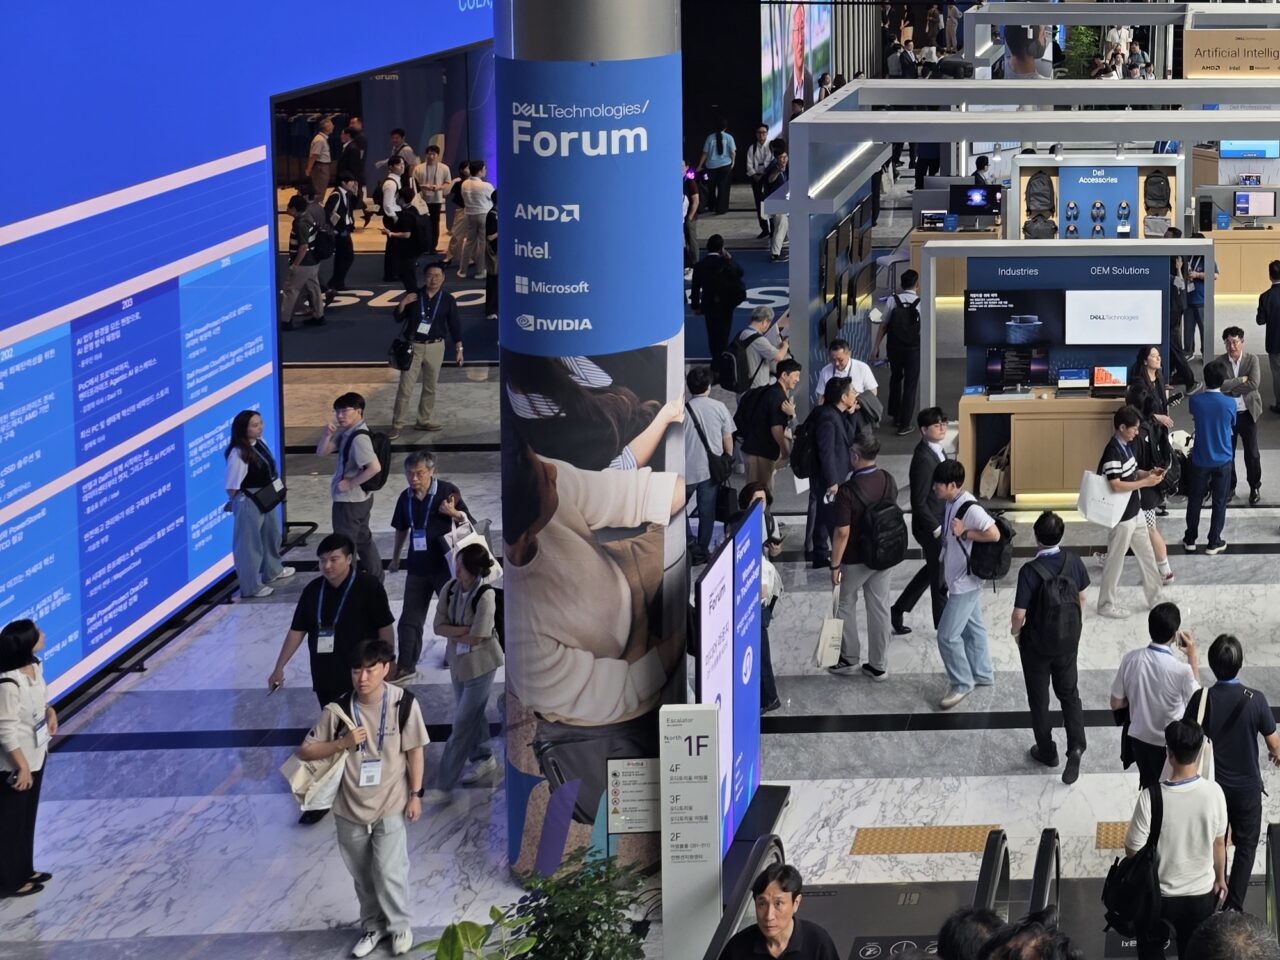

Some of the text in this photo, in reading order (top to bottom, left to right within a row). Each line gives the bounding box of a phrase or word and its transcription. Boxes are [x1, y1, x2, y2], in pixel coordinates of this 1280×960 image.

[1194, 48, 1240, 59] Artificial
[512, 120, 648, 157] Forum
[514, 203, 559, 222] AMD
[998, 268, 1039, 276] Industries
[1090, 267, 1150, 275] OEM Solutions
[531, 280, 590, 294] Microsoft
[121, 297, 133, 309] 203
[1, 348, 14, 362] 202
[709, 584, 726, 616] Forum
[684, 736, 709, 756] 1F
[669, 764, 680, 773] 4F
[670, 795, 680, 804] 3F
[670, 833, 680, 842] 2F
